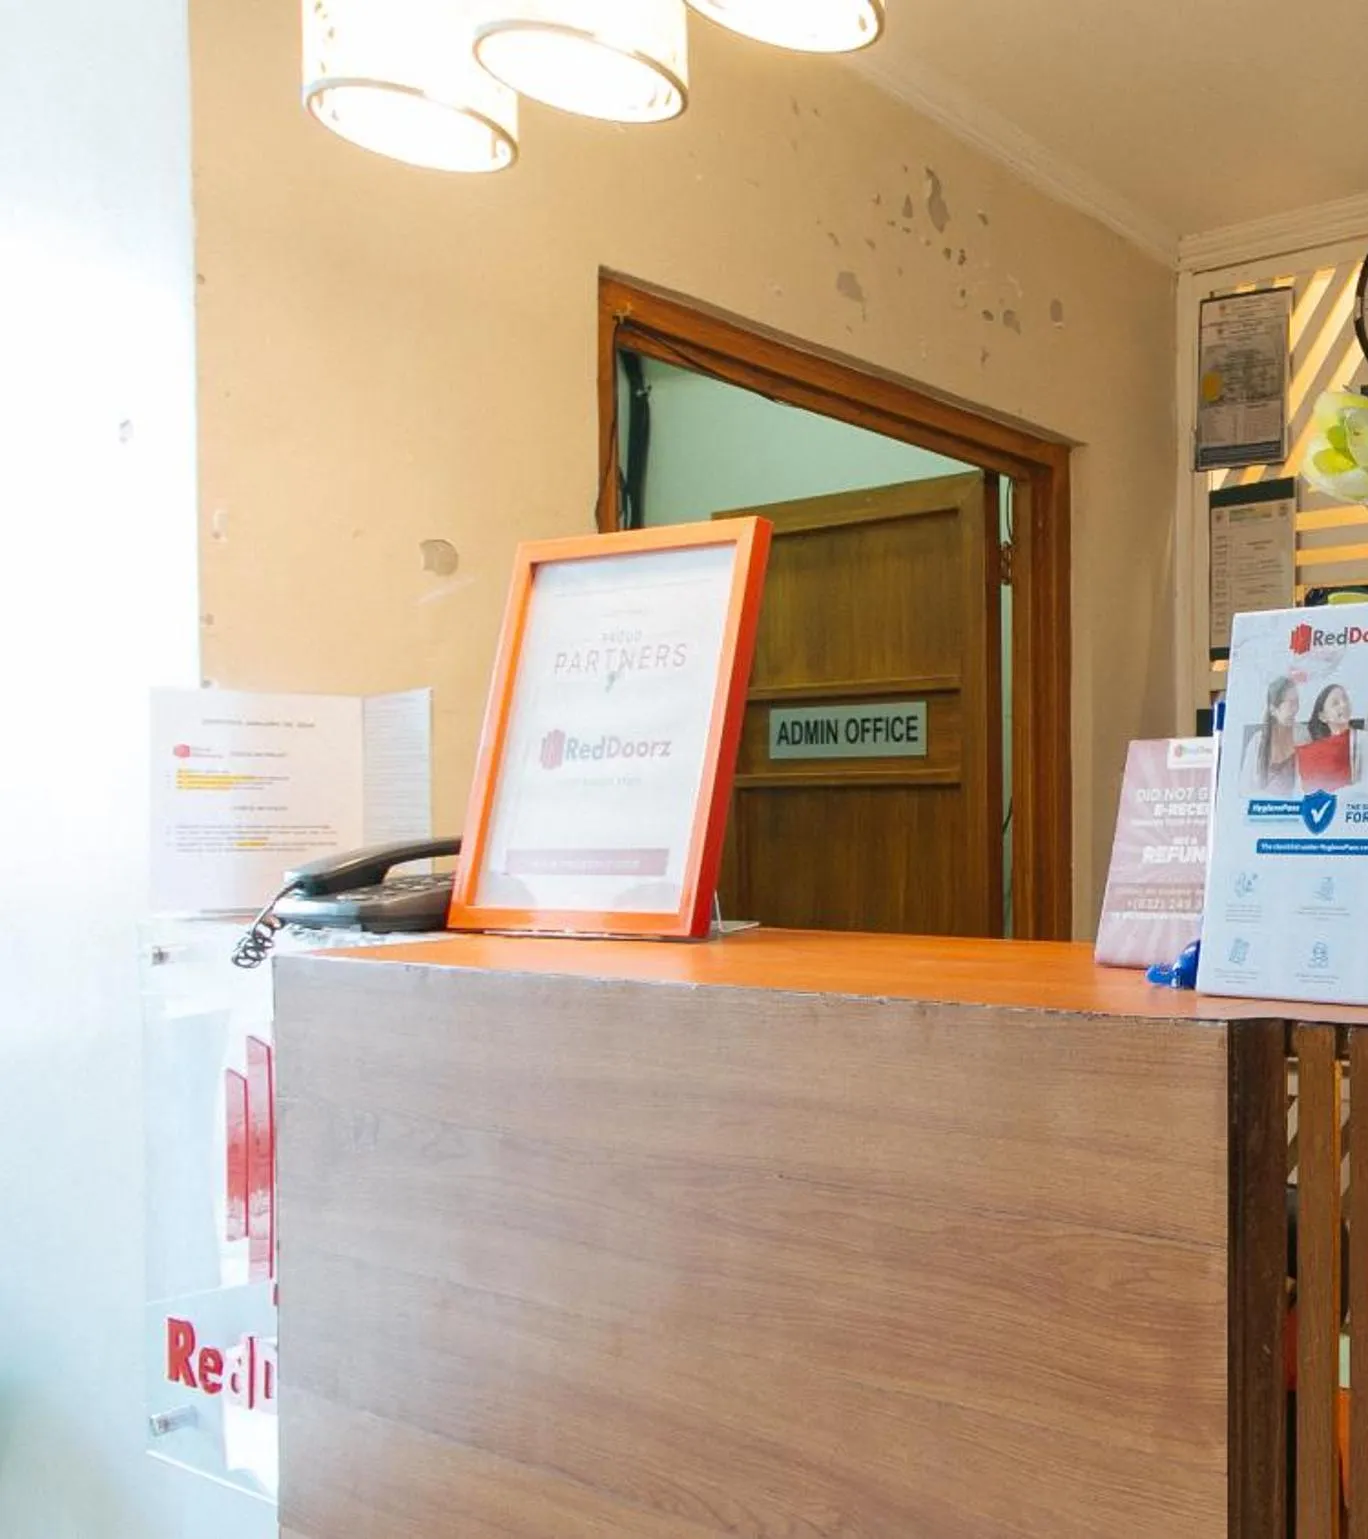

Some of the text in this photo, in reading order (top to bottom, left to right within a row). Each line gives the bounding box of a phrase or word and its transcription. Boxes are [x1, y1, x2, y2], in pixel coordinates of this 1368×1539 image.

[554, 642, 688, 675] PARTNERS
[776, 713, 919, 746] ADMIN OFFICE
[564, 735, 673, 762] RedDoorz
[1142, 845, 1207, 864] REFUN
